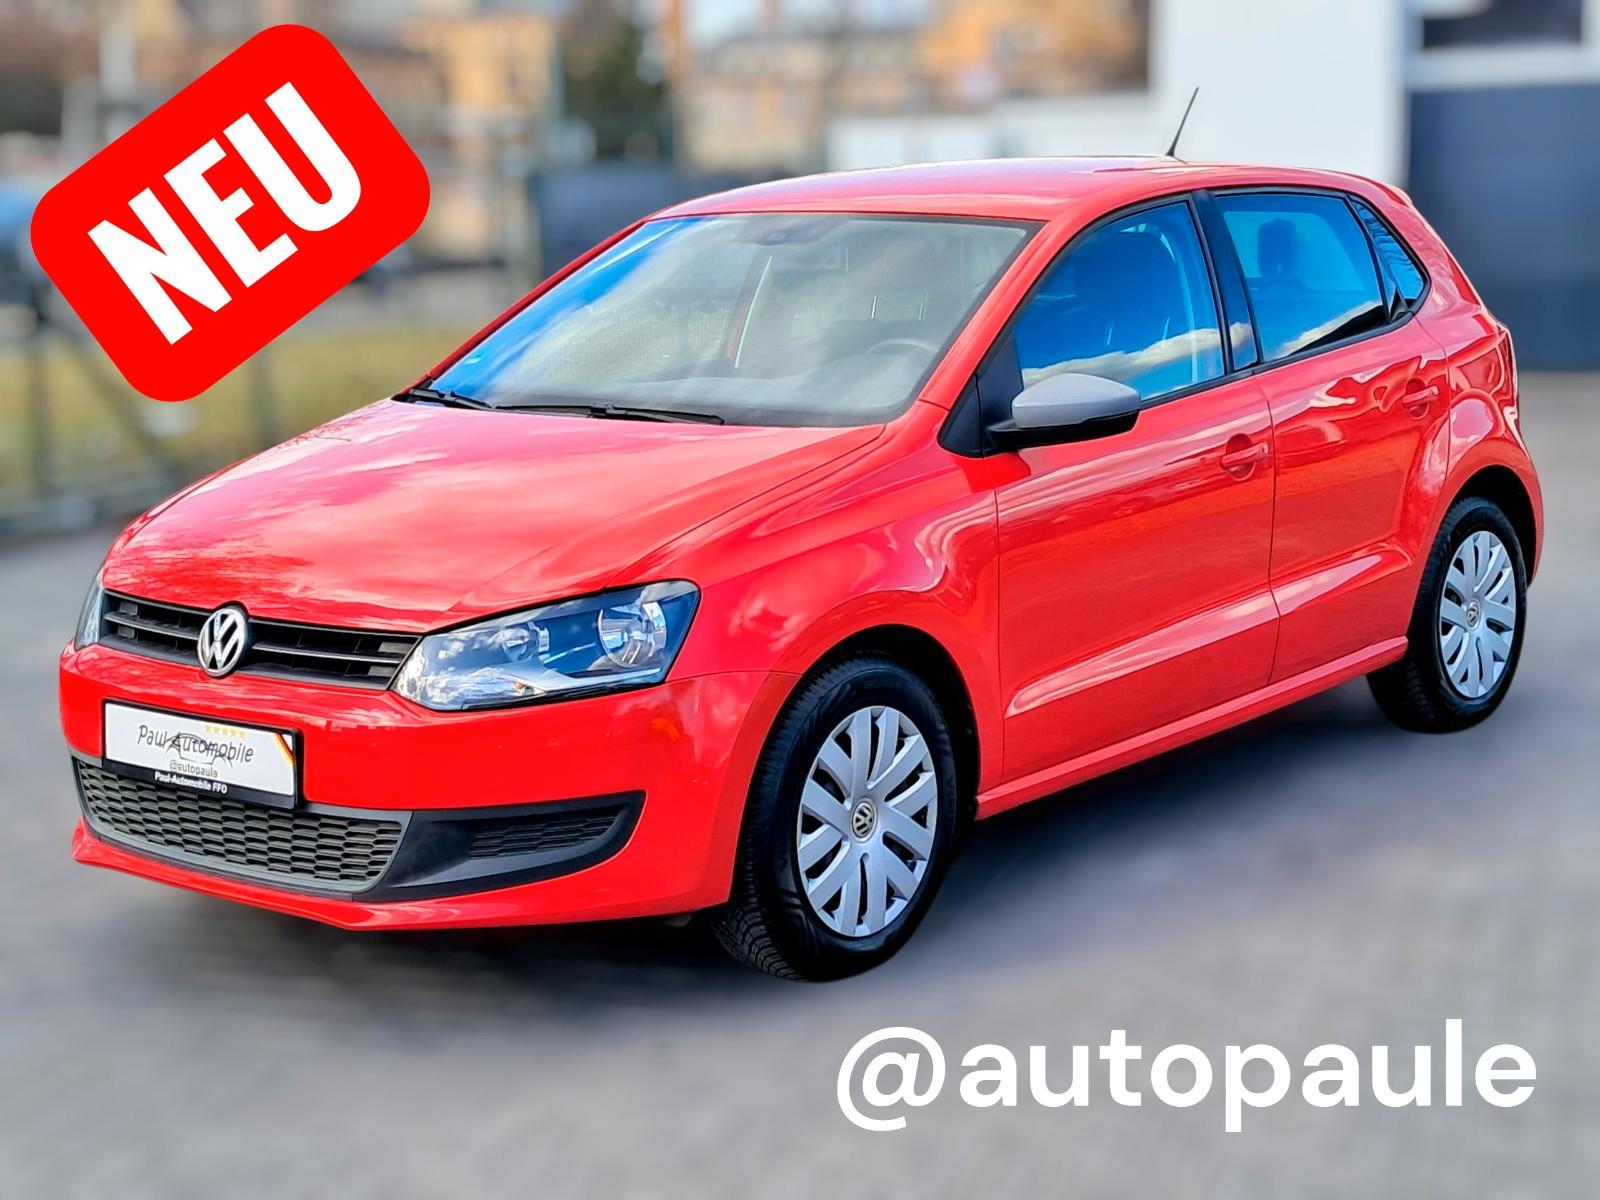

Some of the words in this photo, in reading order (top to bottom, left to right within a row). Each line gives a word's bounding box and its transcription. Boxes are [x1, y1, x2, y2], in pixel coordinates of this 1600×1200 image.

[197, 608, 246, 677] VW
[138, 725, 167, 748] Paul
[172, 732, 254, 763] Automobile
[154, 771, 211, 791] Paul-Automobile
[212, 782, 228, 794] FFO
[169, 759, 218, 778] @autopaule
